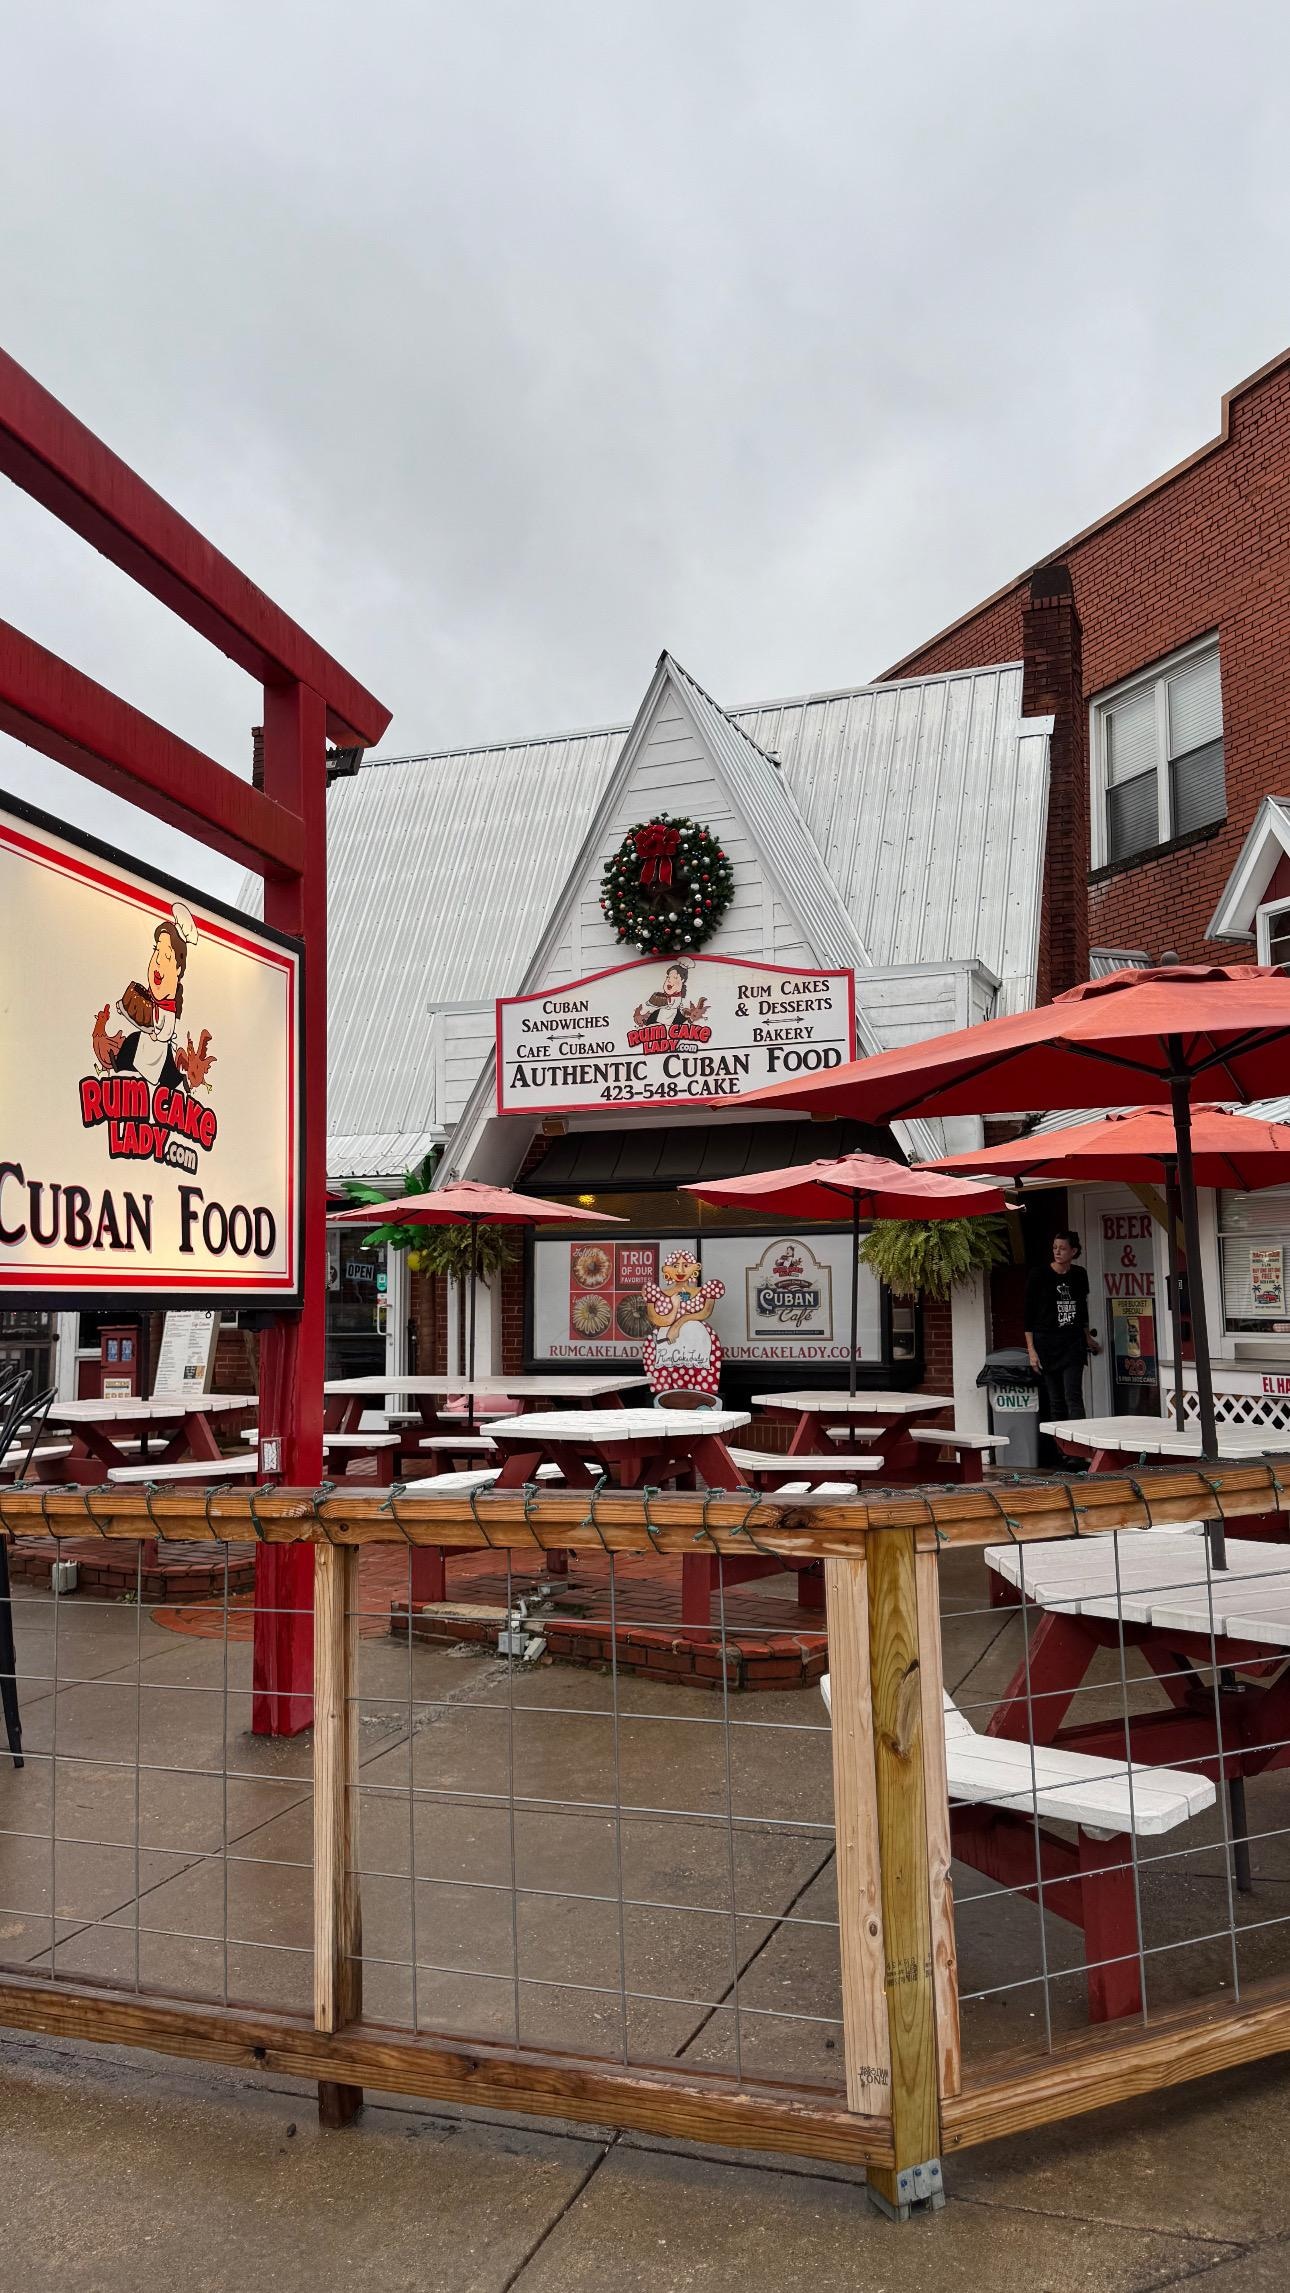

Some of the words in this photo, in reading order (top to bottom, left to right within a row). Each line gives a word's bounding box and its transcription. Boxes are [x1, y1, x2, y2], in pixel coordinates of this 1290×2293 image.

[737, 983, 774, 1000] RUM
[780, 979, 830, 995] CAKES
[542, 1000, 589, 1015] CUBAN
[735, 1002, 749, 1017] &
[758, 997, 833, 1016] DESSERTS
[521, 1015, 610, 1033] SANDWICHES
[752, 1026, 814, 1043] BAKERY
[516, 1044, 551, 1058] CAFE
[558, 1040, 615, 1055] CUBANO
[509, 1060, 648, 1089] AUTHENTIC
[662, 1053, 750, 1079] CUBAN
[767, 1046, 843, 1074] FOOD
[600, 1078, 741, 1102] 423-548-CAKE
[0, 1162, 153, 1252] CUBAN
[179, 1185, 277, 1258] FOOD
[1102, 1215, 1152, 1240] BEER
[622, 1251, 653, 1265] TRIO
[1120, 1244, 1137, 1267] &
[347, 1264, 373, 1279] OPEN
[621, 1267, 632, 1276] OF
[635, 1267, 653, 1276] OUR
[1104, 1273, 1155, 1297] WINE
[760, 1290, 814, 1310] CUBAN
[1262, 1376, 1275, 1393] EL
[997, 1395, 1030, 1407] ONLY
